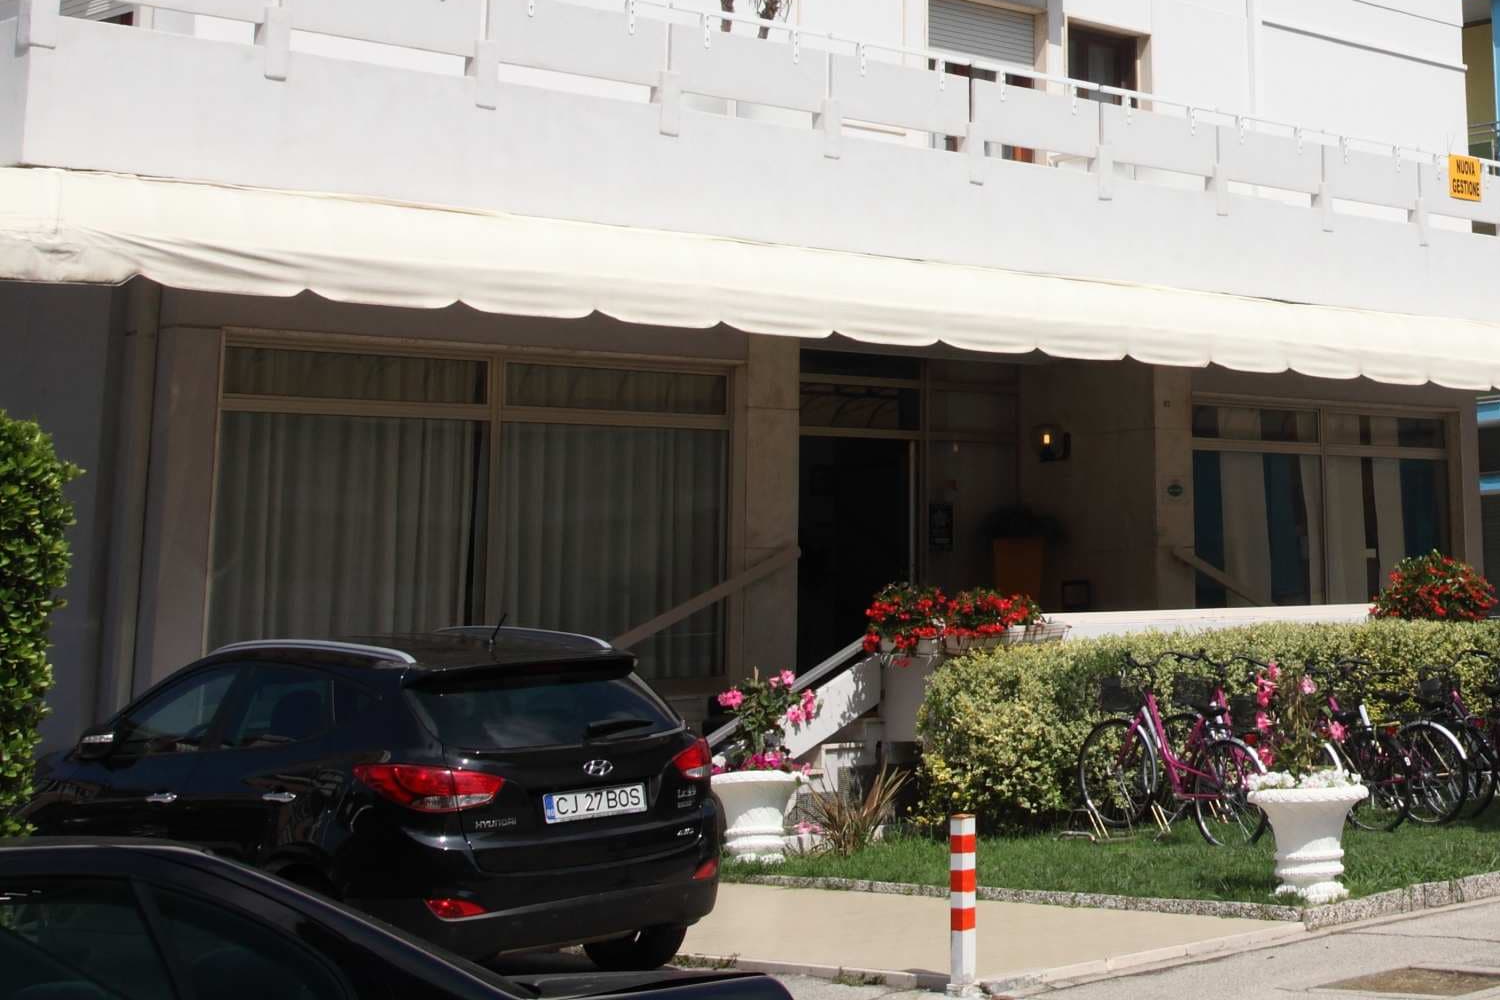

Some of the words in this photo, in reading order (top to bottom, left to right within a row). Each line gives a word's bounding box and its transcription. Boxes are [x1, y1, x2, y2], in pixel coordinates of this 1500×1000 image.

[1456, 159, 1476, 176] NUOVA
[1452, 178, 1480, 197] GESTIONE
[556, 795, 579, 815] CJ
[584, 792, 603, 811] 27
[606, 788, 641, 809] BOS
[475, 817, 517, 829] HYUNDAI
